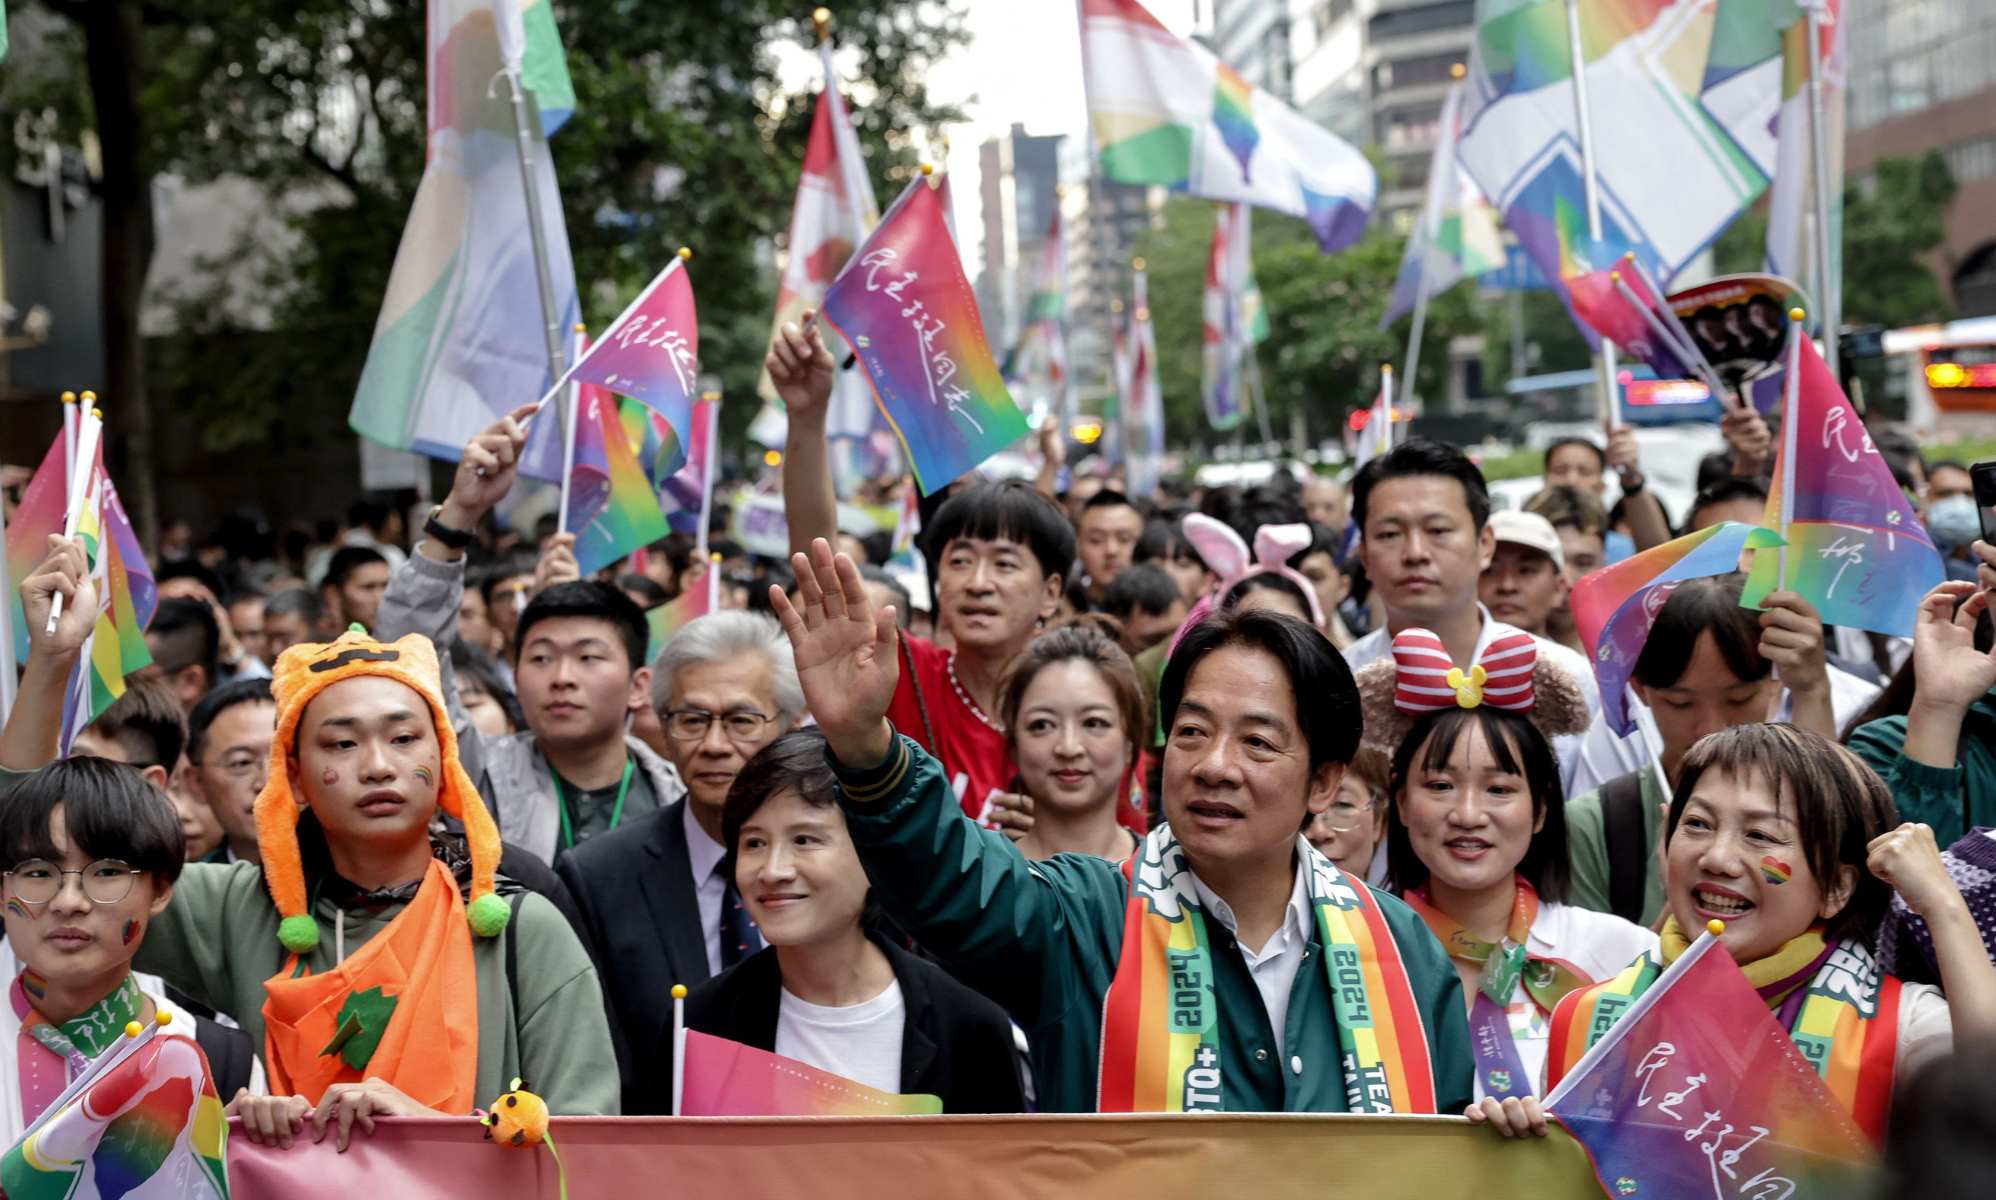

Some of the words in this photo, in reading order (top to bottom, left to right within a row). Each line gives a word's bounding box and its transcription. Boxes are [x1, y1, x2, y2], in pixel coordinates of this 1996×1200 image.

[1168, 954, 1203, 1027] 2024
[1331, 950, 1369, 1022] 2024
[1186, 1047, 1222, 1113] TQ+
